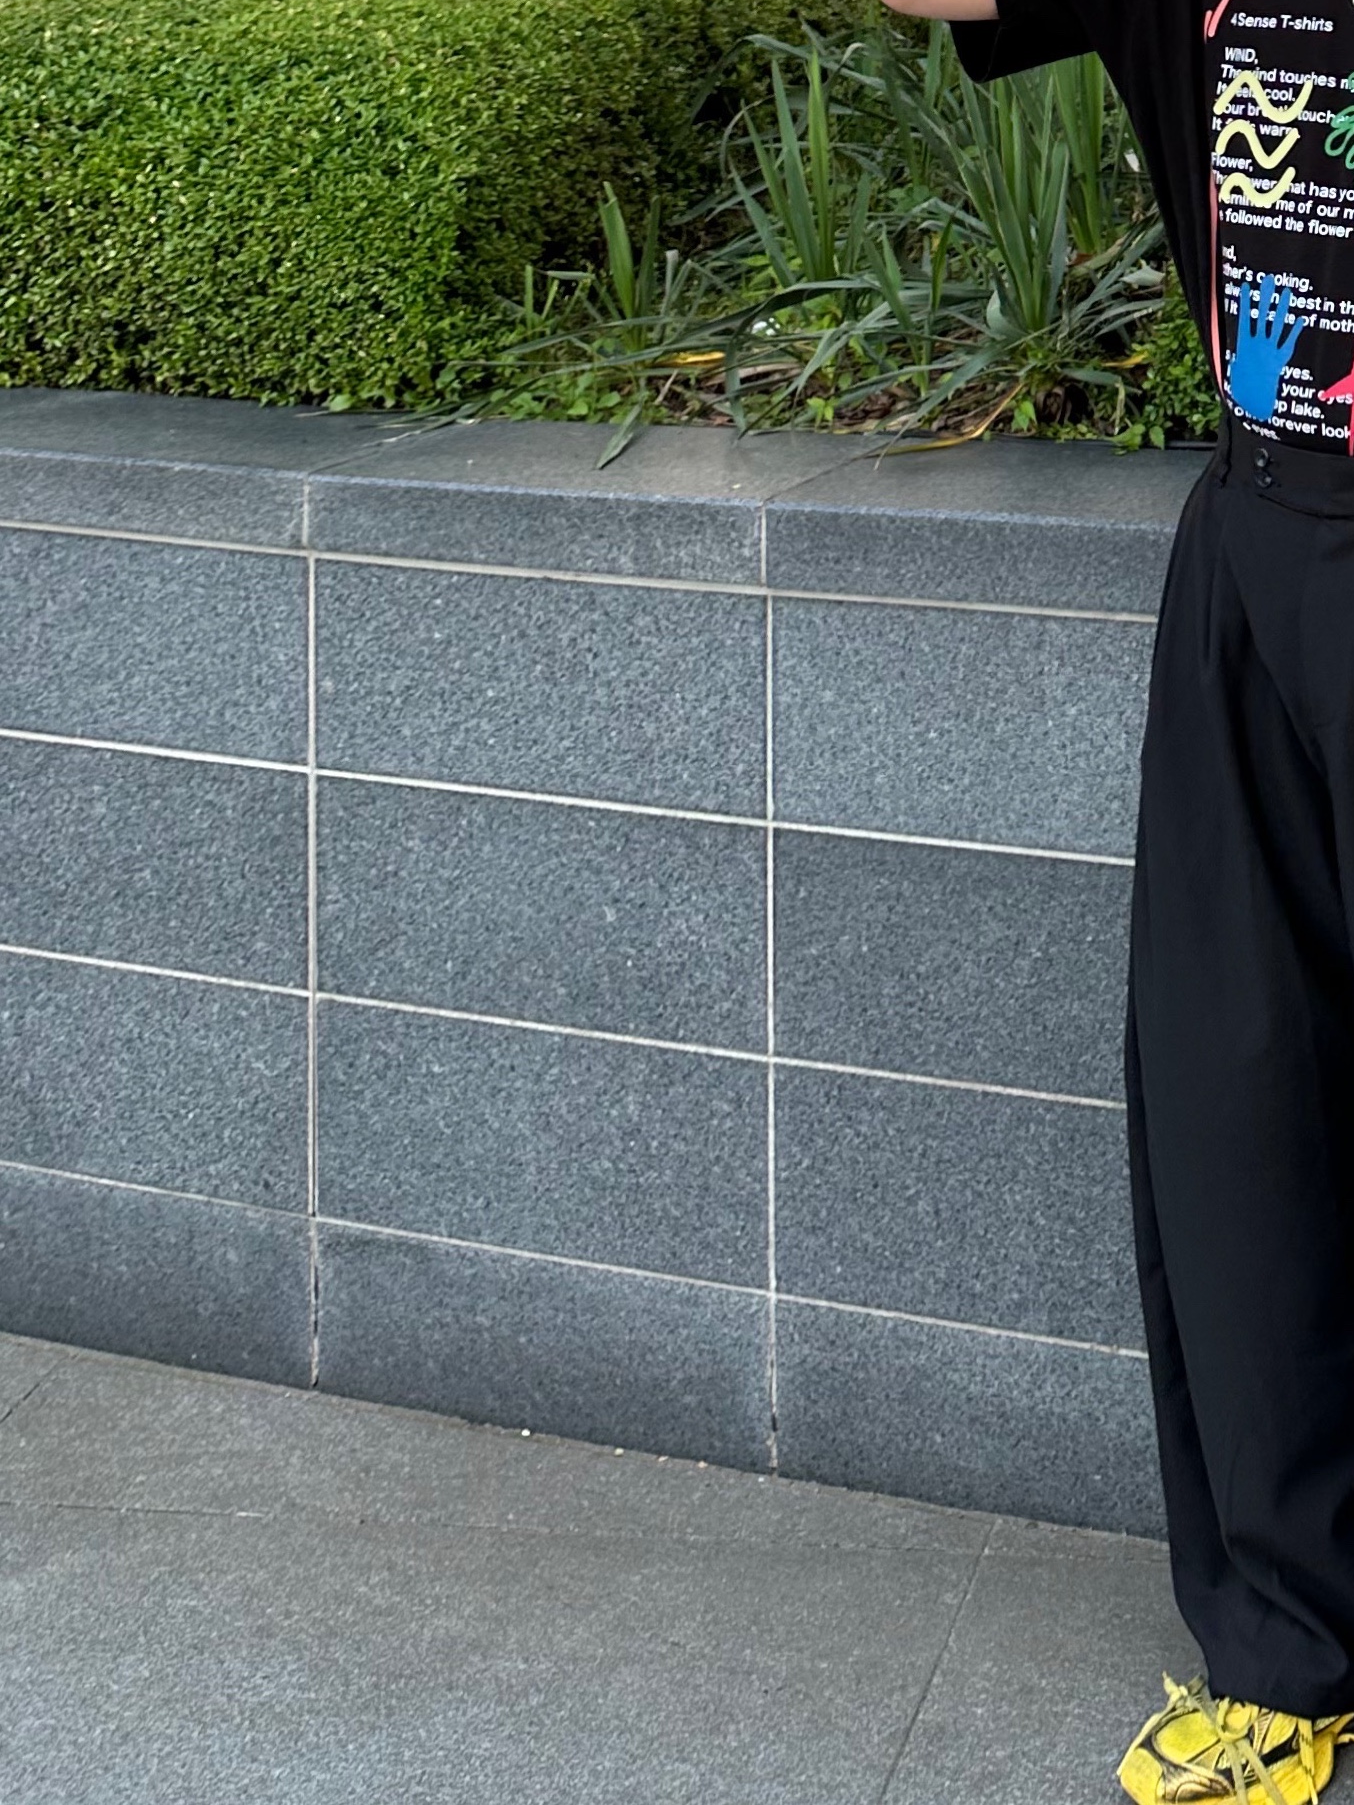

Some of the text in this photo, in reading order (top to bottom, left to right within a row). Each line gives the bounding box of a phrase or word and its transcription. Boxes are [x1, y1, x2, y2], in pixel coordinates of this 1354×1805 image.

[1230, 12, 1334, 33] 4Sense T-shirts
[1248, 66, 1278, 83] ind
[1279, 69, 1337, 88] touches
[1264, 87, 1297, 102] cool.
[1214, 98, 1246, 115] our
[1211, 115, 1223, 132] It
[1211, 151, 1254, 173] Flower,
[1285, 180, 1307, 196] hat
[1308, 181, 1337, 200] has
[1275, 198, 1296, 213] me
[1297, 200, 1314, 215] of
[1316, 204, 1341, 219] our
[1225, 208, 1283, 229] followed
[1284, 216, 1305, 232] the
[1308, 219, 1354, 239] flower
[1256, 272, 1314, 293] coking.
[1289, 293, 1322, 311] best
[1323, 296, 1335, 313] in
[1281, 382, 1316, 399] your
[1290, 399, 1325, 419] lake.
